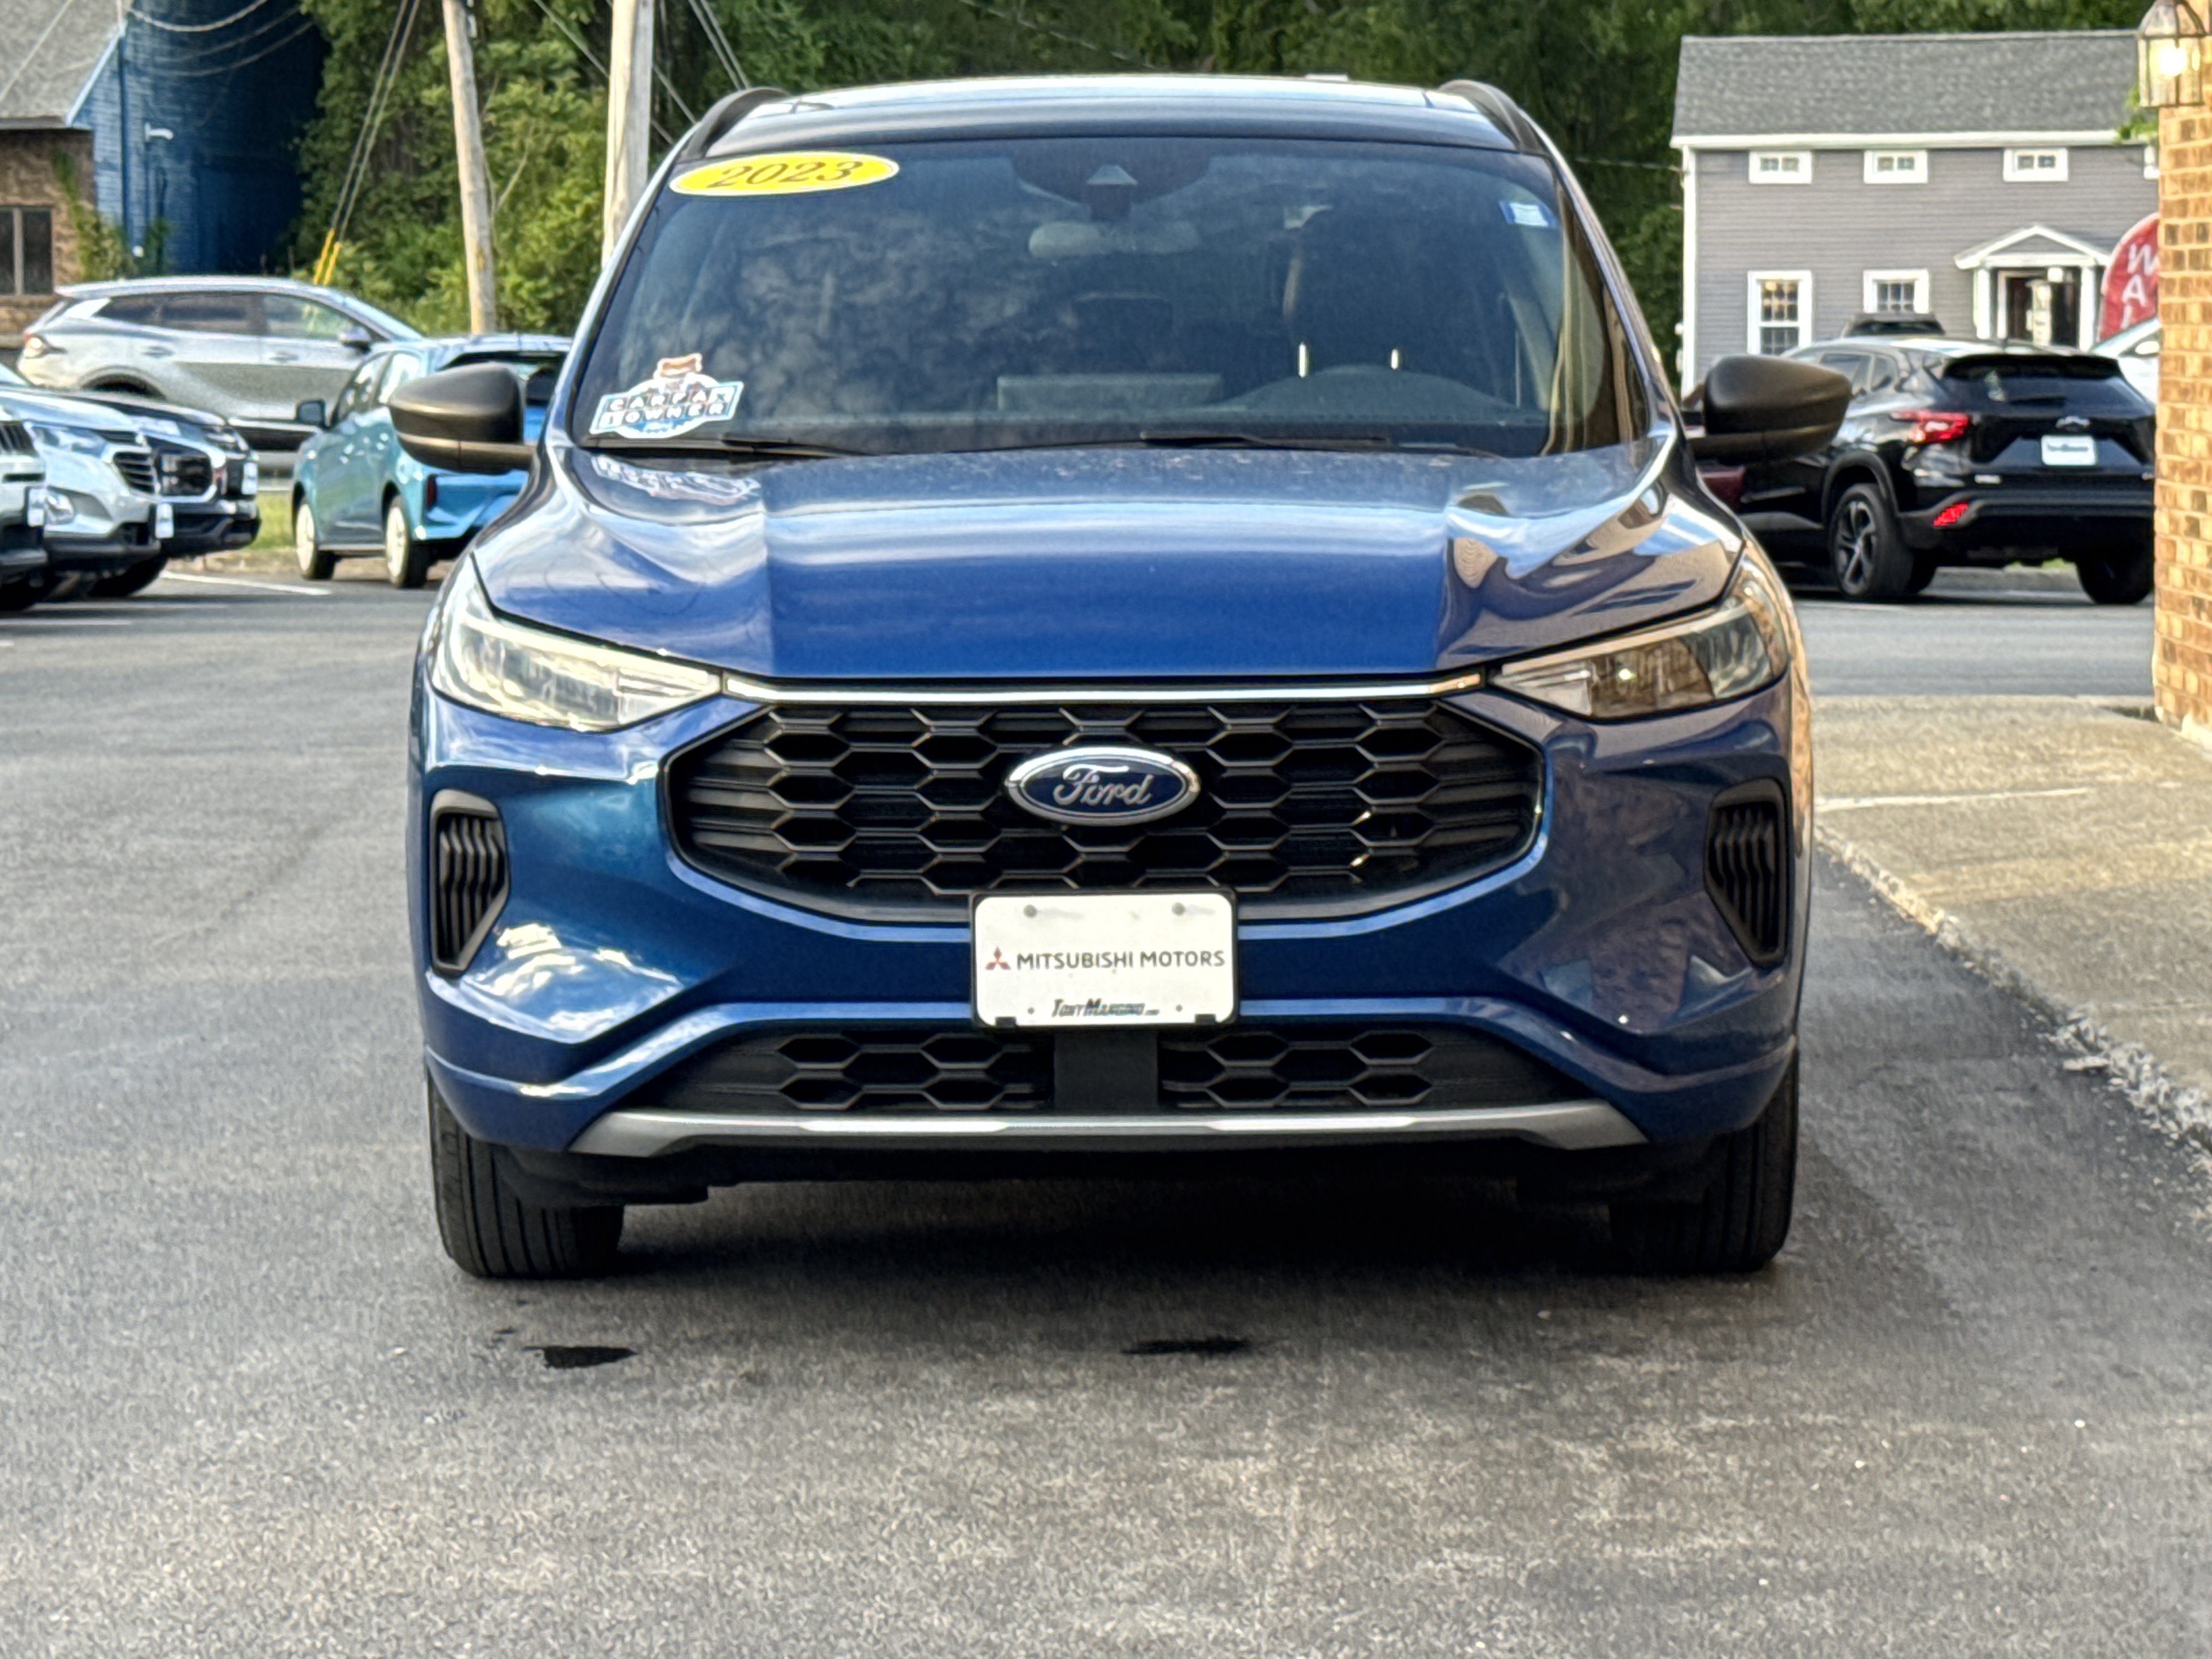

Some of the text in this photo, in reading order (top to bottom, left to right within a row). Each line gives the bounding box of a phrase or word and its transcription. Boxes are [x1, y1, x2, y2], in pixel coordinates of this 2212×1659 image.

[706, 161, 864, 188] 2023
[1053, 764, 1154, 806] Ford
[1016, 950, 1226, 970] MITSUBISHI MOTORS
